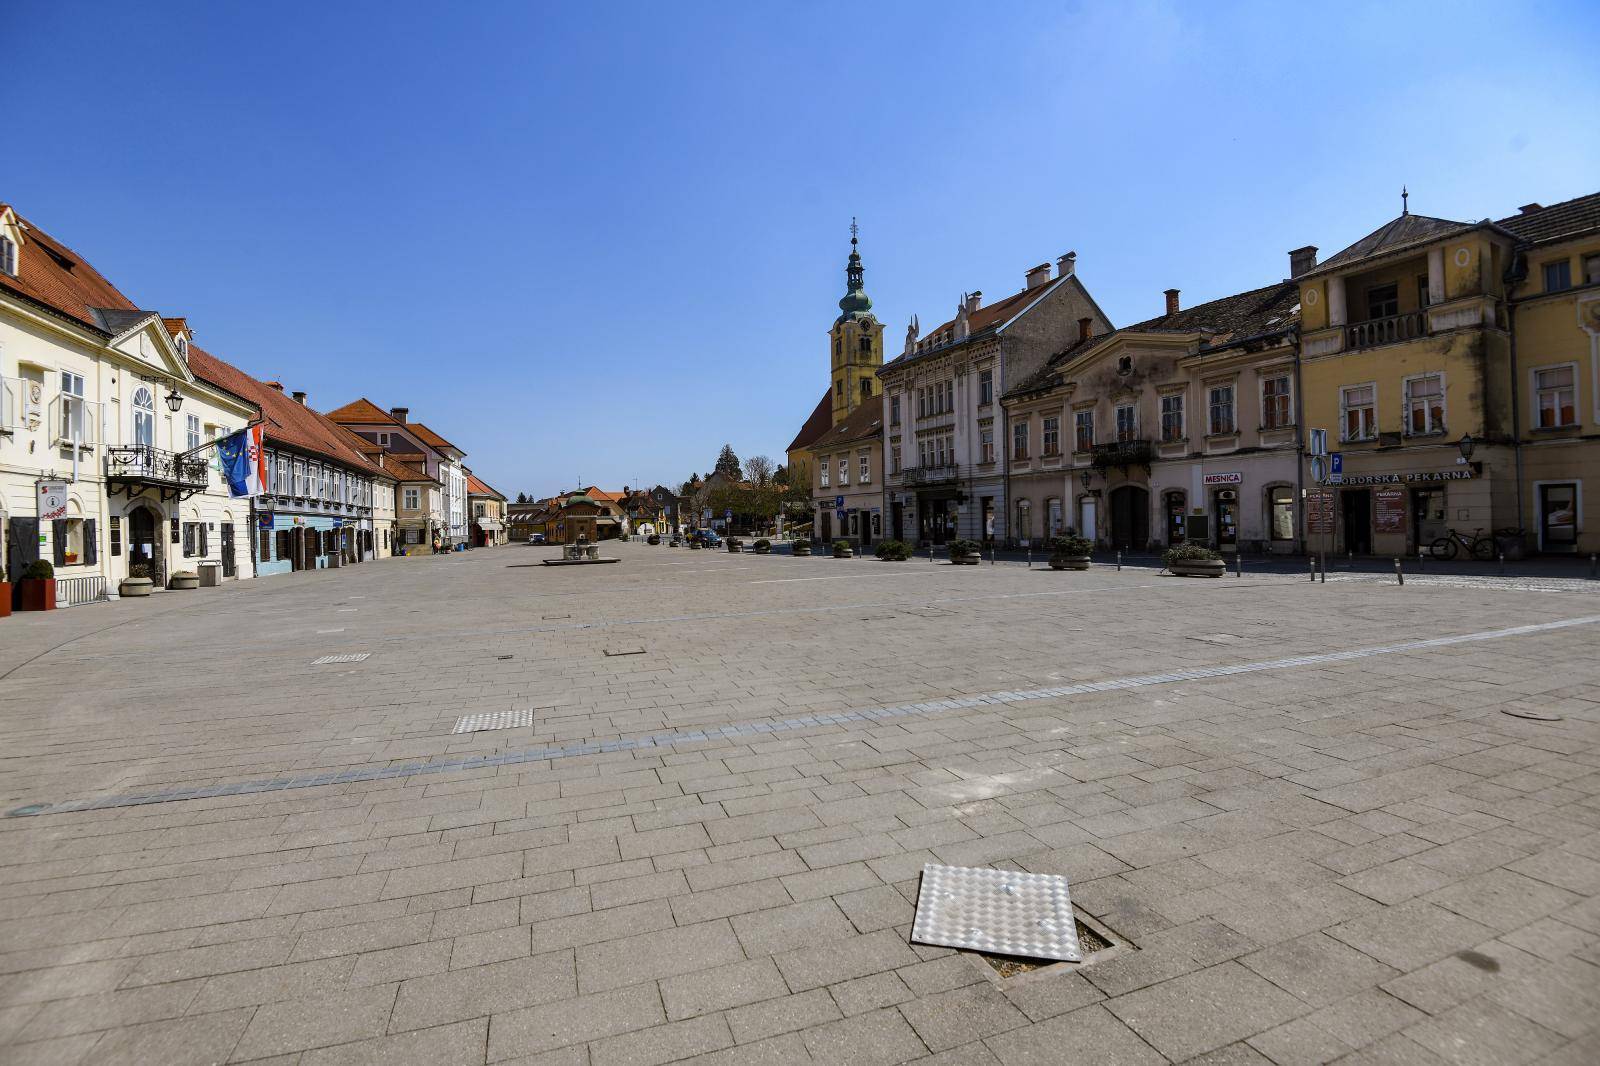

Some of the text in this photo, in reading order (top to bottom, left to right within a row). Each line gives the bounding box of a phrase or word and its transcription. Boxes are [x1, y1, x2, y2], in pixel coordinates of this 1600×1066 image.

[1334, 457, 1339, 470] P
[1205, 474, 1240, 483] MESNICA
[1321, 473, 1399, 486] AOBORSKA
[1406, 470, 1471, 482] PEKARNA
